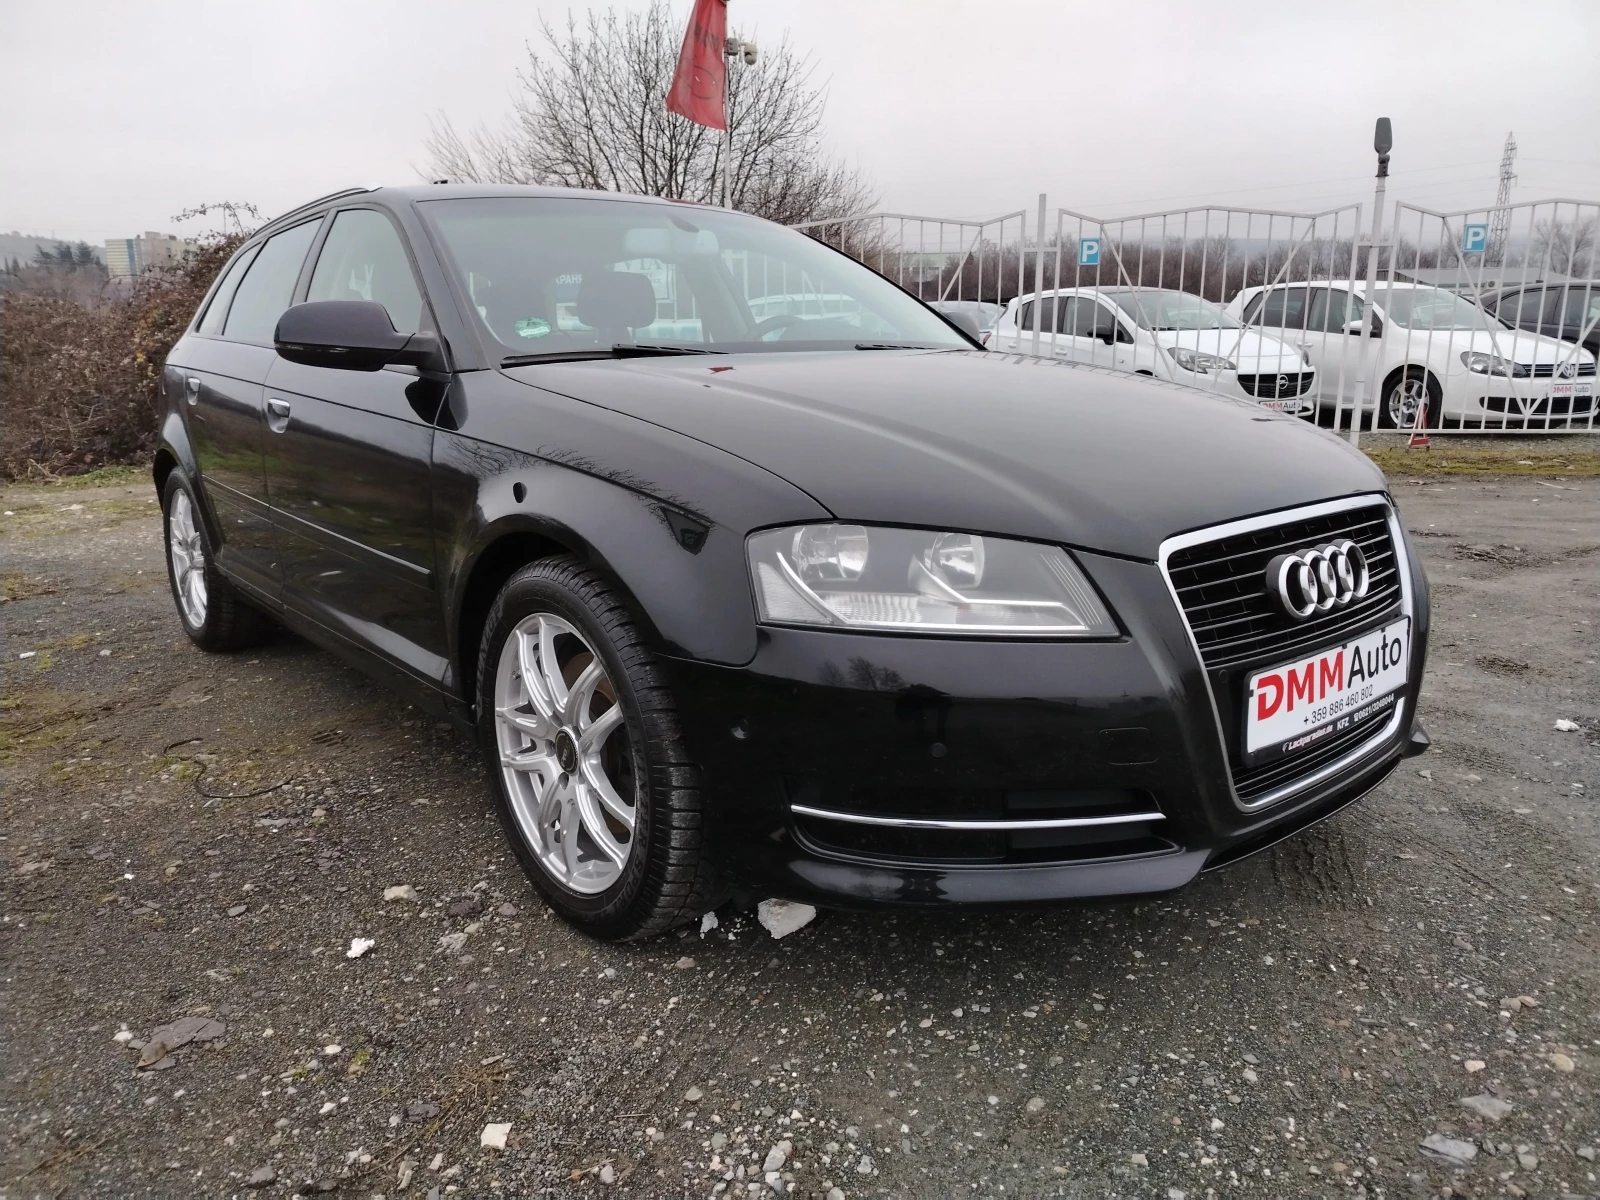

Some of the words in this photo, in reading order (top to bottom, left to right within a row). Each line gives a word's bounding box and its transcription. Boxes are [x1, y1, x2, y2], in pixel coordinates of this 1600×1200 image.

[1466, 227, 1485, 249] P
[1082, 241, 1099, 262] P
[1311, 706, 1327, 724] 359
[1329, 699, 1344, 717] 886
[1345, 690, 1359, 708] 460
[1360, 684, 1374, 701] 802
[1336, 716, 1350, 731] KFZ
